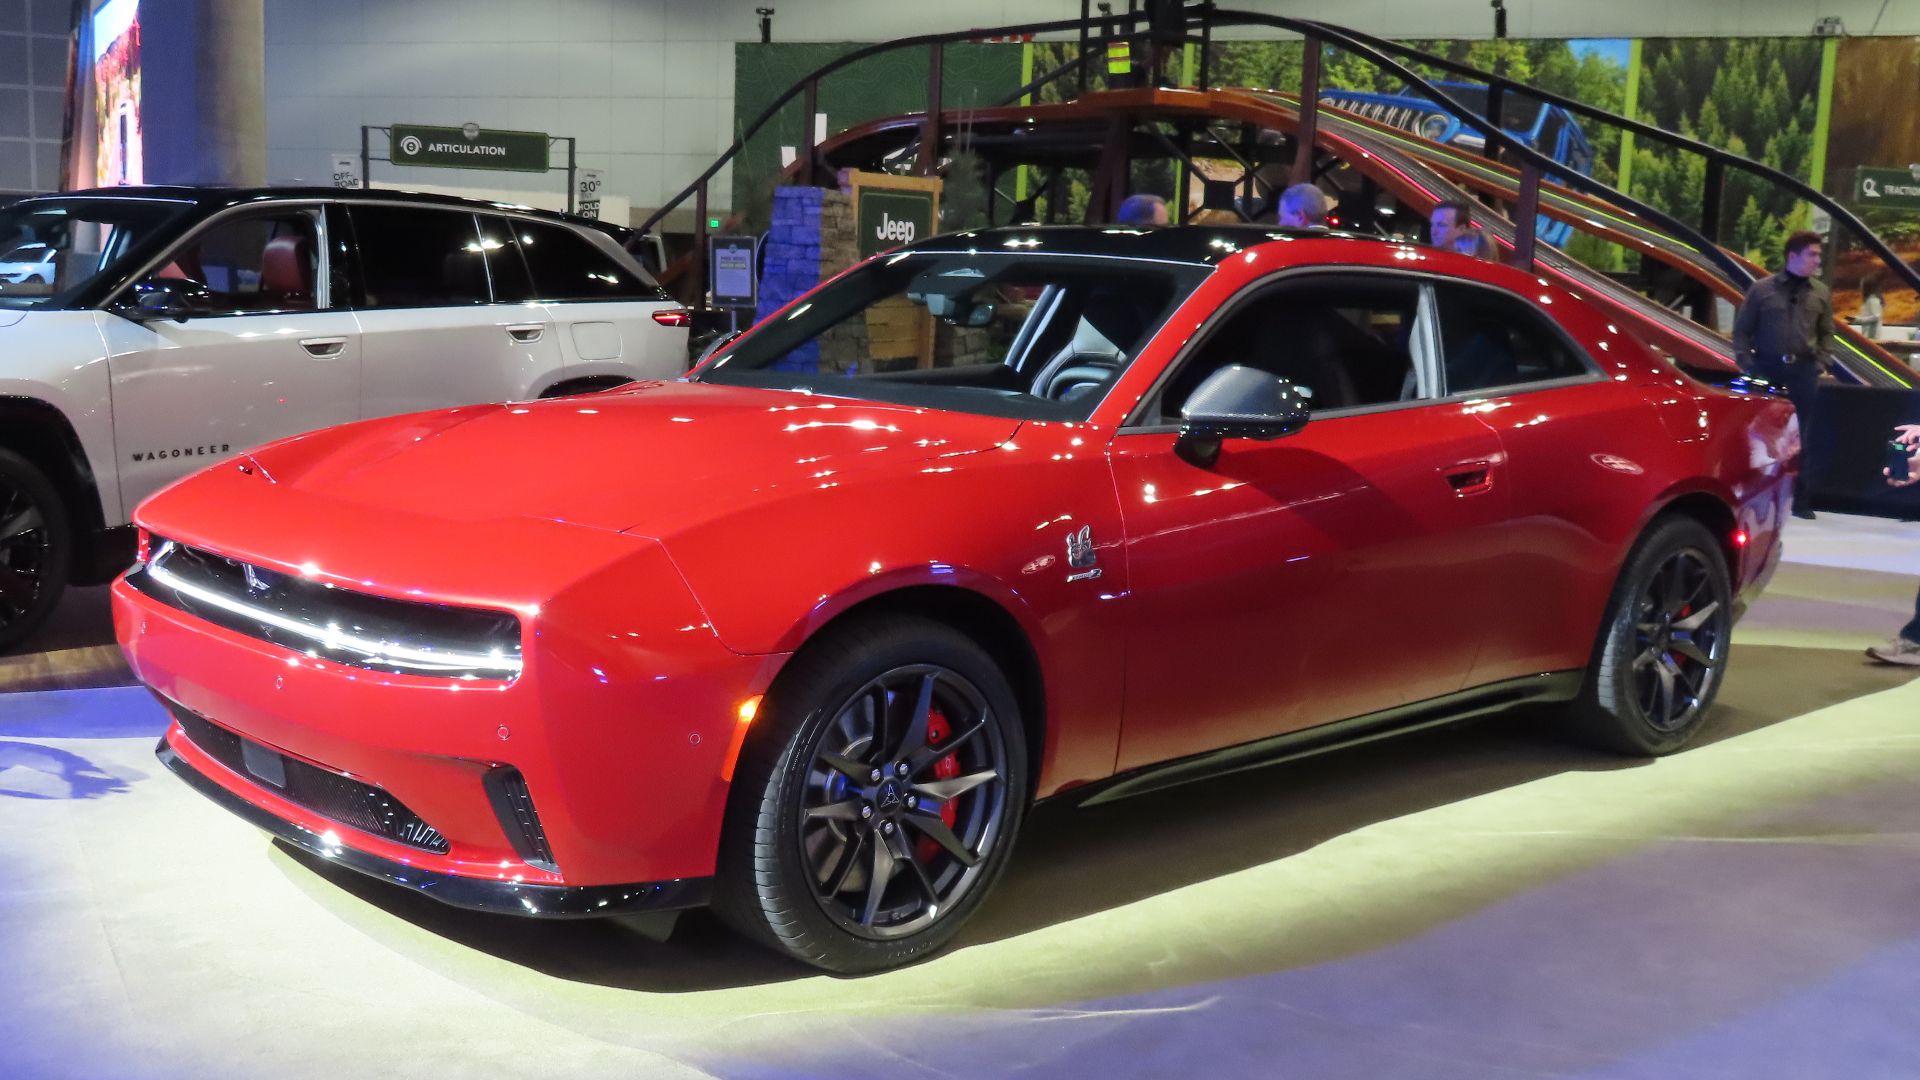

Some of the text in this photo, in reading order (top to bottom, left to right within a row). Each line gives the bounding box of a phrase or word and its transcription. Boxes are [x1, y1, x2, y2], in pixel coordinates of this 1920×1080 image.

[428, 143, 506, 156] ARTICULATION
[877, 213, 915, 245] Jeep
[133, 444, 229, 462] WAGONEER
